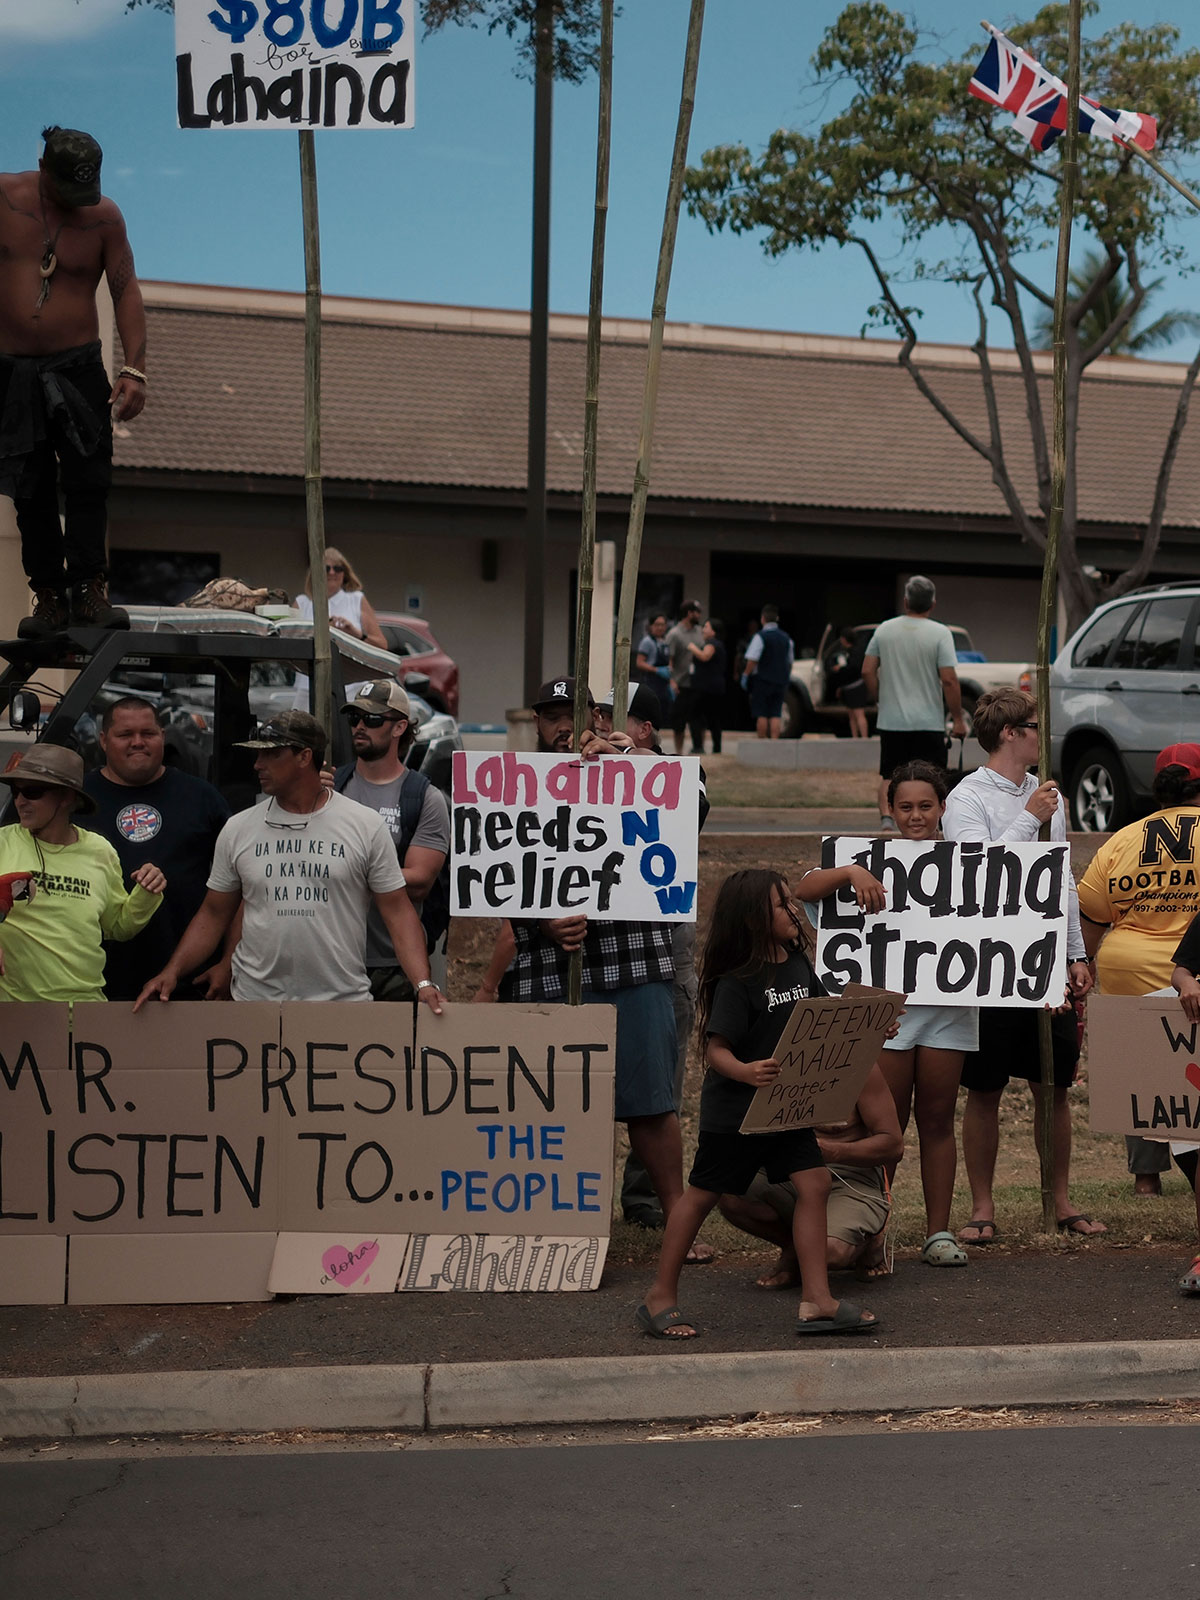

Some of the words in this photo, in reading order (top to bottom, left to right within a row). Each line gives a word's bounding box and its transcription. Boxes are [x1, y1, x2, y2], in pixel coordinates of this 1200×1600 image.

[207, 0, 404, 51] $80B
[349, 38, 393, 50] Billion
[256, 43, 339, 70] for
[176, 53, 410, 128] Lahaina
[452, 752, 683, 810] Lahaina
[255, 842, 270, 857] UA
[275, 840, 302, 854] MAU
[309, 840, 324, 854] KE
[331, 843, 345, 858] EA
[454, 805, 608, 856] needs
[1138, 814, 1200, 867] N
[64, 876, 90, 888] MAUI
[265, 864, 273, 878] O
[280, 862, 295, 877] KA
[457, 851, 625, 912] relief
[621, 808, 697, 914] NOW
[274, 886, 288, 901] KA
[296, 886, 329, 903] PONO
[1133, 889, 1199, 902] Champions
[820, 923, 1058, 1001] strong
[791, 1002, 895, 1045] DEFEND
[0, 1041, 136, 1115] MR.
[207, 1038, 609, 1116] PRESIDENT
[779, 1038, 861, 1076] MAUI
[766, 1103, 815, 1127] AINA
[790, 1096, 812, 1108] our
[477, 1125, 566, 1161] THE
[0, 1130, 265, 1223] LISTEN
[441, 1170, 602, 1212] PEOPLE
[319, 1238, 379, 1286] aloha
[402, 1233, 600, 1293] Lahaina
